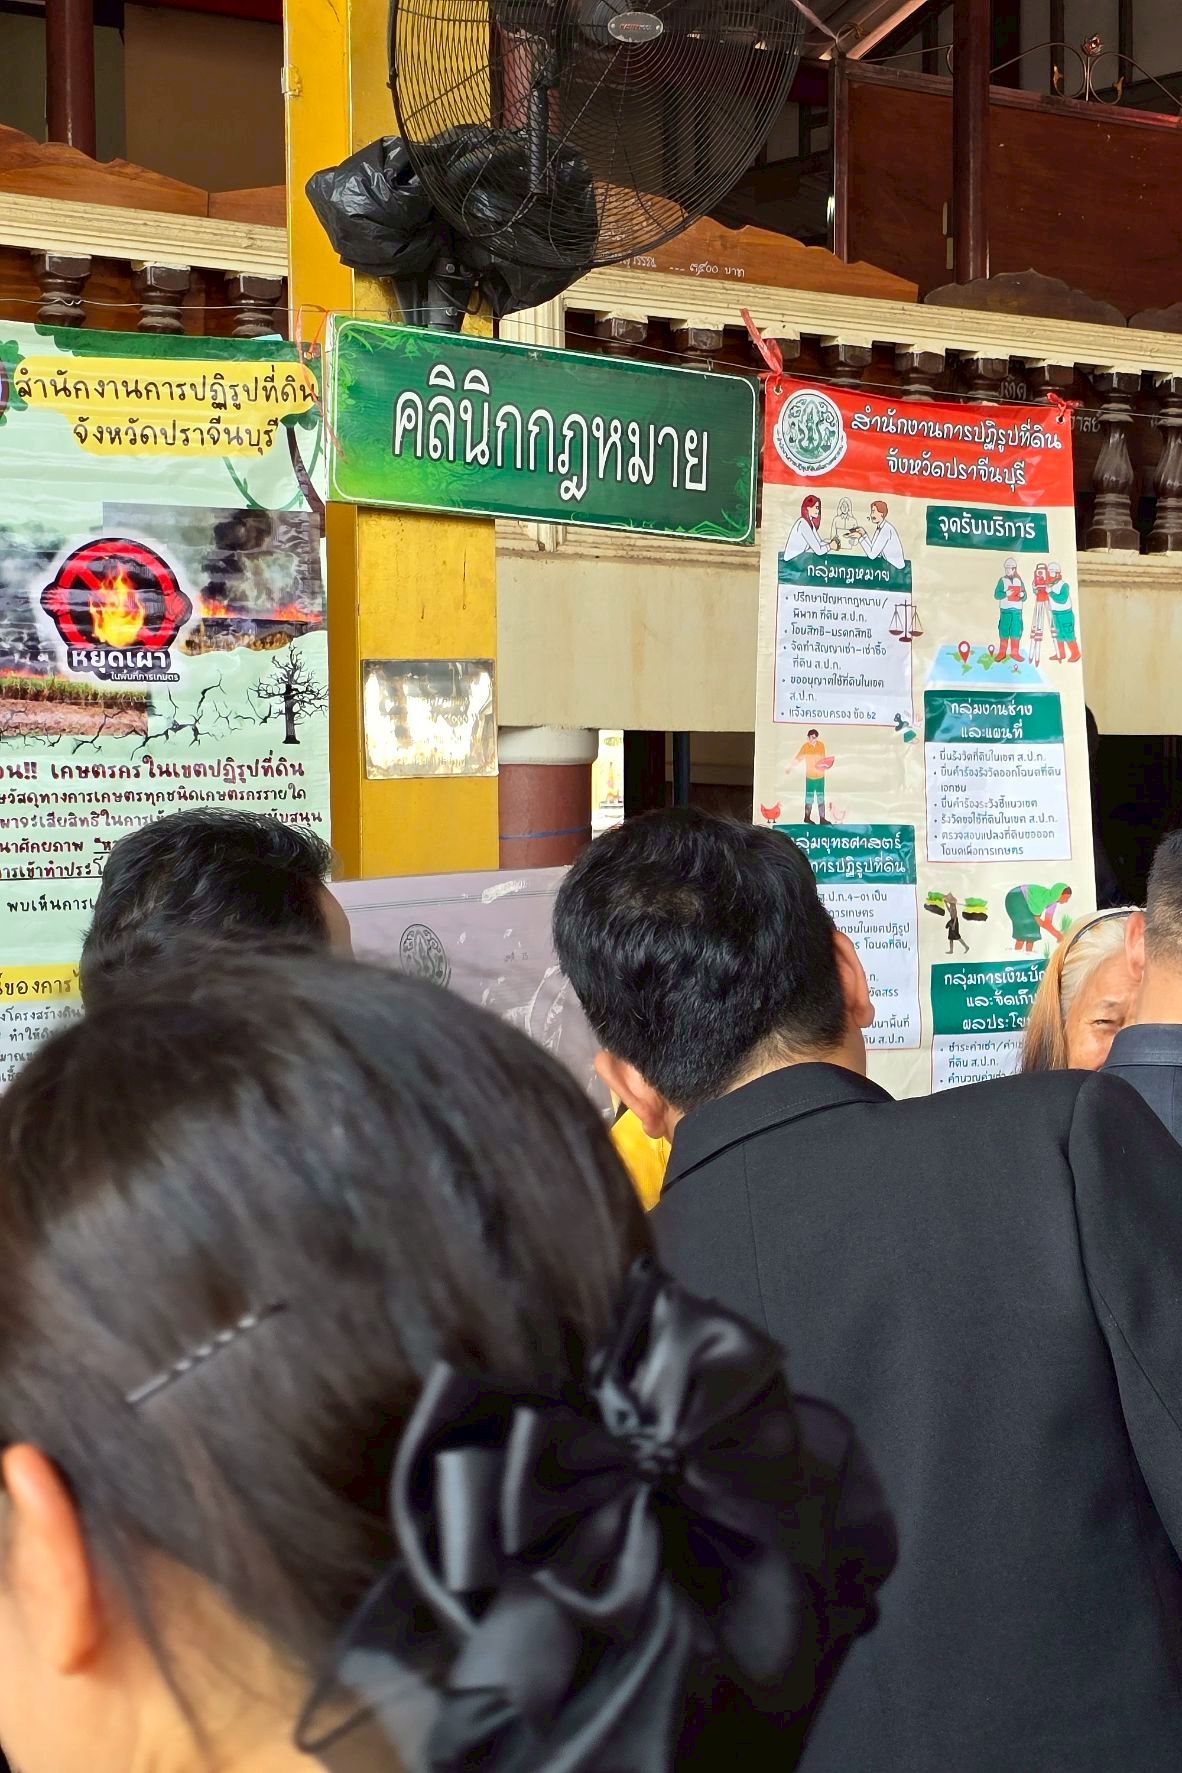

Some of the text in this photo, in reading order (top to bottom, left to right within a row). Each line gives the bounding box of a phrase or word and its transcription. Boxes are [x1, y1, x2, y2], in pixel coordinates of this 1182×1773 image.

[724, 267, 745, 278] บาท
[15, 365, 318, 410] สำนักงานการปฏิรูปที่ดิน
[73, 416, 279, 455] จังหวัดปราจีนบุรี
[393, 363, 708, 501] คลินิกกฎหมาย
[850, 405, 1062, 452] สำนักงานการปฏิรูปที่ดิน
[886, 448, 1026, 492] จังหวัดปราจีนบุรี
[937, 511, 1036, 540] จุดรับบริการ
[806, 560, 890, 584] กลุ่มกฎหมาย
[71, 649, 167, 674] หยุดเผา
[951, 699, 1033, 720] กลุ่มงานช่าง
[960, 719, 1024, 739] และแผนที่
[794, 831, 902, 854] ลุ่มยุทธศาสตร์
[962, 1011, 1029, 1030] ผลประโย
